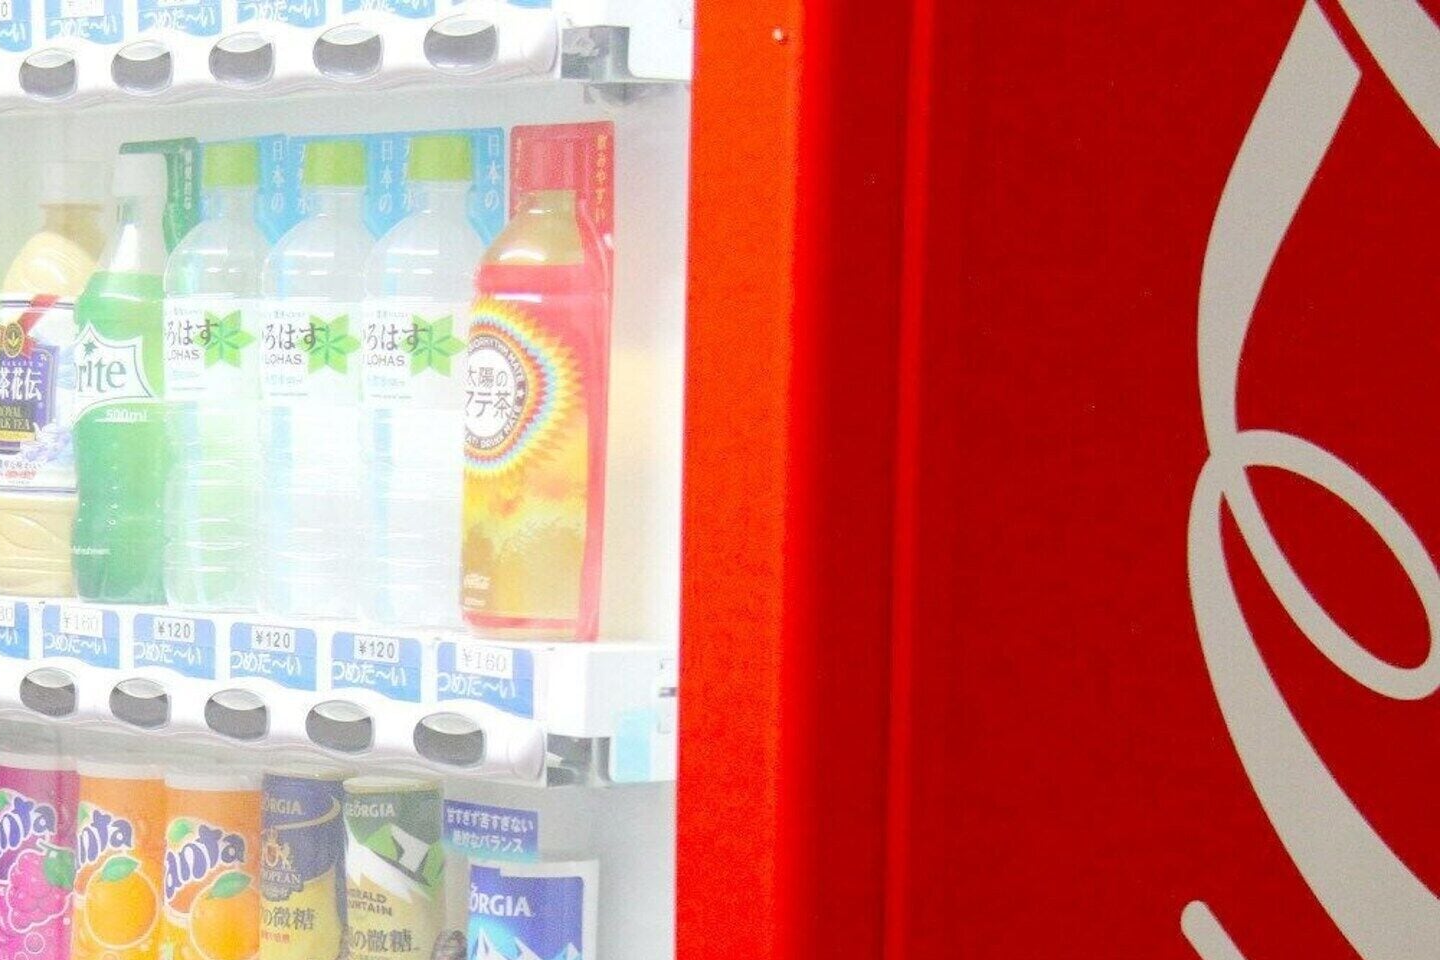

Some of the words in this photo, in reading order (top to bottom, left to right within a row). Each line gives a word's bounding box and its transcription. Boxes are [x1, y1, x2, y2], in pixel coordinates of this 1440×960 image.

[166, 318, 220, 348] ろはす
[76, 359, 128, 394] rite
[157, 621, 192, 639] ¥120
[255, 630, 291, 649] ¥120
[359, 641, 395, 660] ¥120
[263, 799, 302, 815] ORGIA
[77, 809, 134, 866] nta
[164, 823, 247, 900] anta
[469, 892, 535, 917] ORGIA
[262, 906, 315, 931] の微糖
